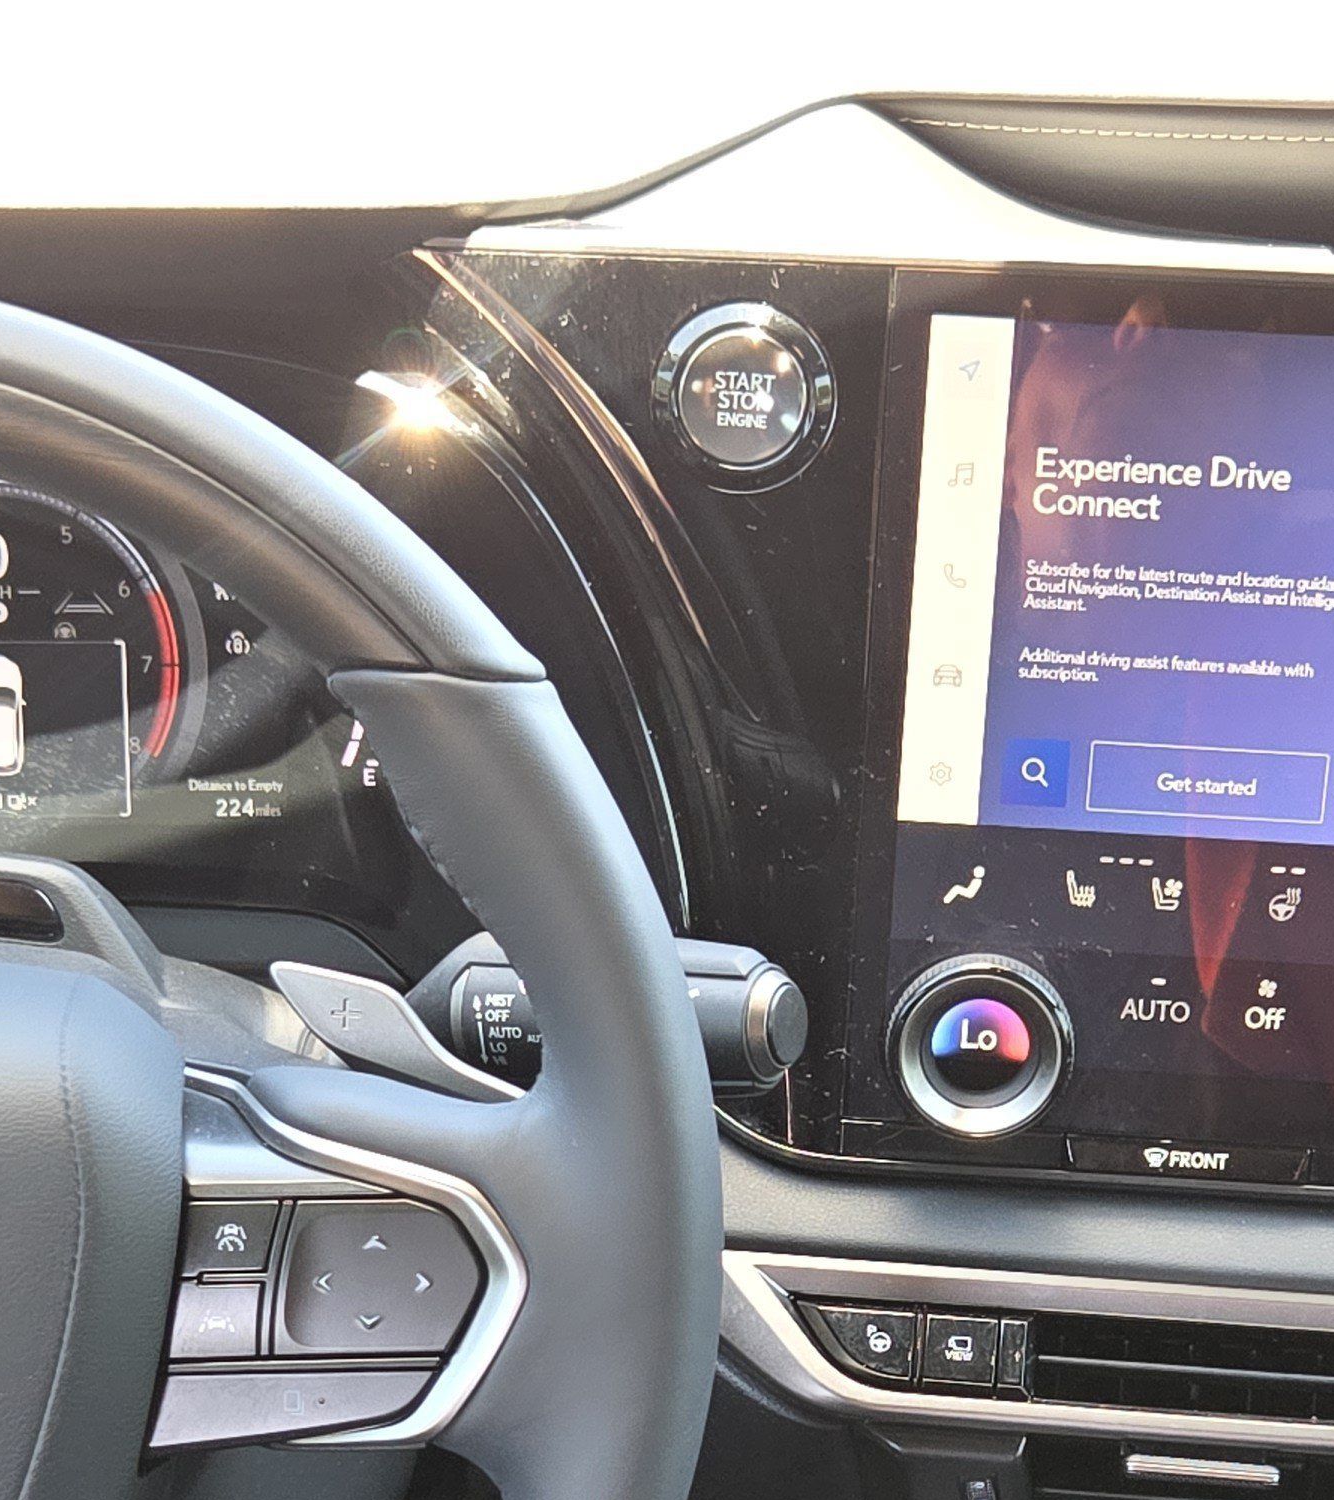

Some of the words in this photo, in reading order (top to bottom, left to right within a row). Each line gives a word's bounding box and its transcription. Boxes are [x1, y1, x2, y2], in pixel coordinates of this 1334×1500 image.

[715, 371, 776, 392] START
[718, 390, 774, 412] STO
[717, 411, 768, 430] ENGINE
[1034, 447, 1203, 487] Experience
[1210, 455, 1292, 491] Drive
[1032, 483, 1162, 521] Connect
[61, 526, 72, 544] 5
[1026, 560, 1090, 579] Subscribe
[1093, 563, 1112, 580] for
[1114, 564, 1136, 581] the
[1139, 566, 1176, 583] latest
[1177, 570, 1214, 586] route
[1216, 571, 1240, 587] and
[1243, 572, 1294, 589] location
[118, 580, 130, 598] 6
[1025, 577, 1066, 594] Cloud
[1068, 579, 1142, 600] Navigation,
[1144, 583, 1219, 603] Destination
[1221, 588, 1260, 604] Assist
[1263, 590, 1287, 606] and
[1023, 593, 1087, 612] Assistant.
[142, 655, 153, 673] 7
[1019, 647, 1085, 665] Additional
[1087, 650, 1130, 671] driving
[1133, 654, 1168, 670] assist
[1171, 655, 1224, 674] features
[1227, 659, 1281, 677] available
[1284, 662, 1314, 678] with
[1018, 665, 1099, 683] subscription.
[188, 778, 232, 792] Distance
[234, 780, 247, 792] to
[248, 778, 283, 794] Empty
[363, 768, 376, 786] E
[1157, 774, 1191, 794] Get
[1195, 777, 1257, 797] started
[216, 798, 254, 817] 224
[485, 1008, 511, 1022] OFF
[1121, 998, 1190, 1024] AUTO
[1244, 1006, 1286, 1031] Off
[488, 1026, 522, 1039] AUTO
[960, 1018, 998, 1051] Lo
[1169, 1151, 1230, 1172] FRONT
